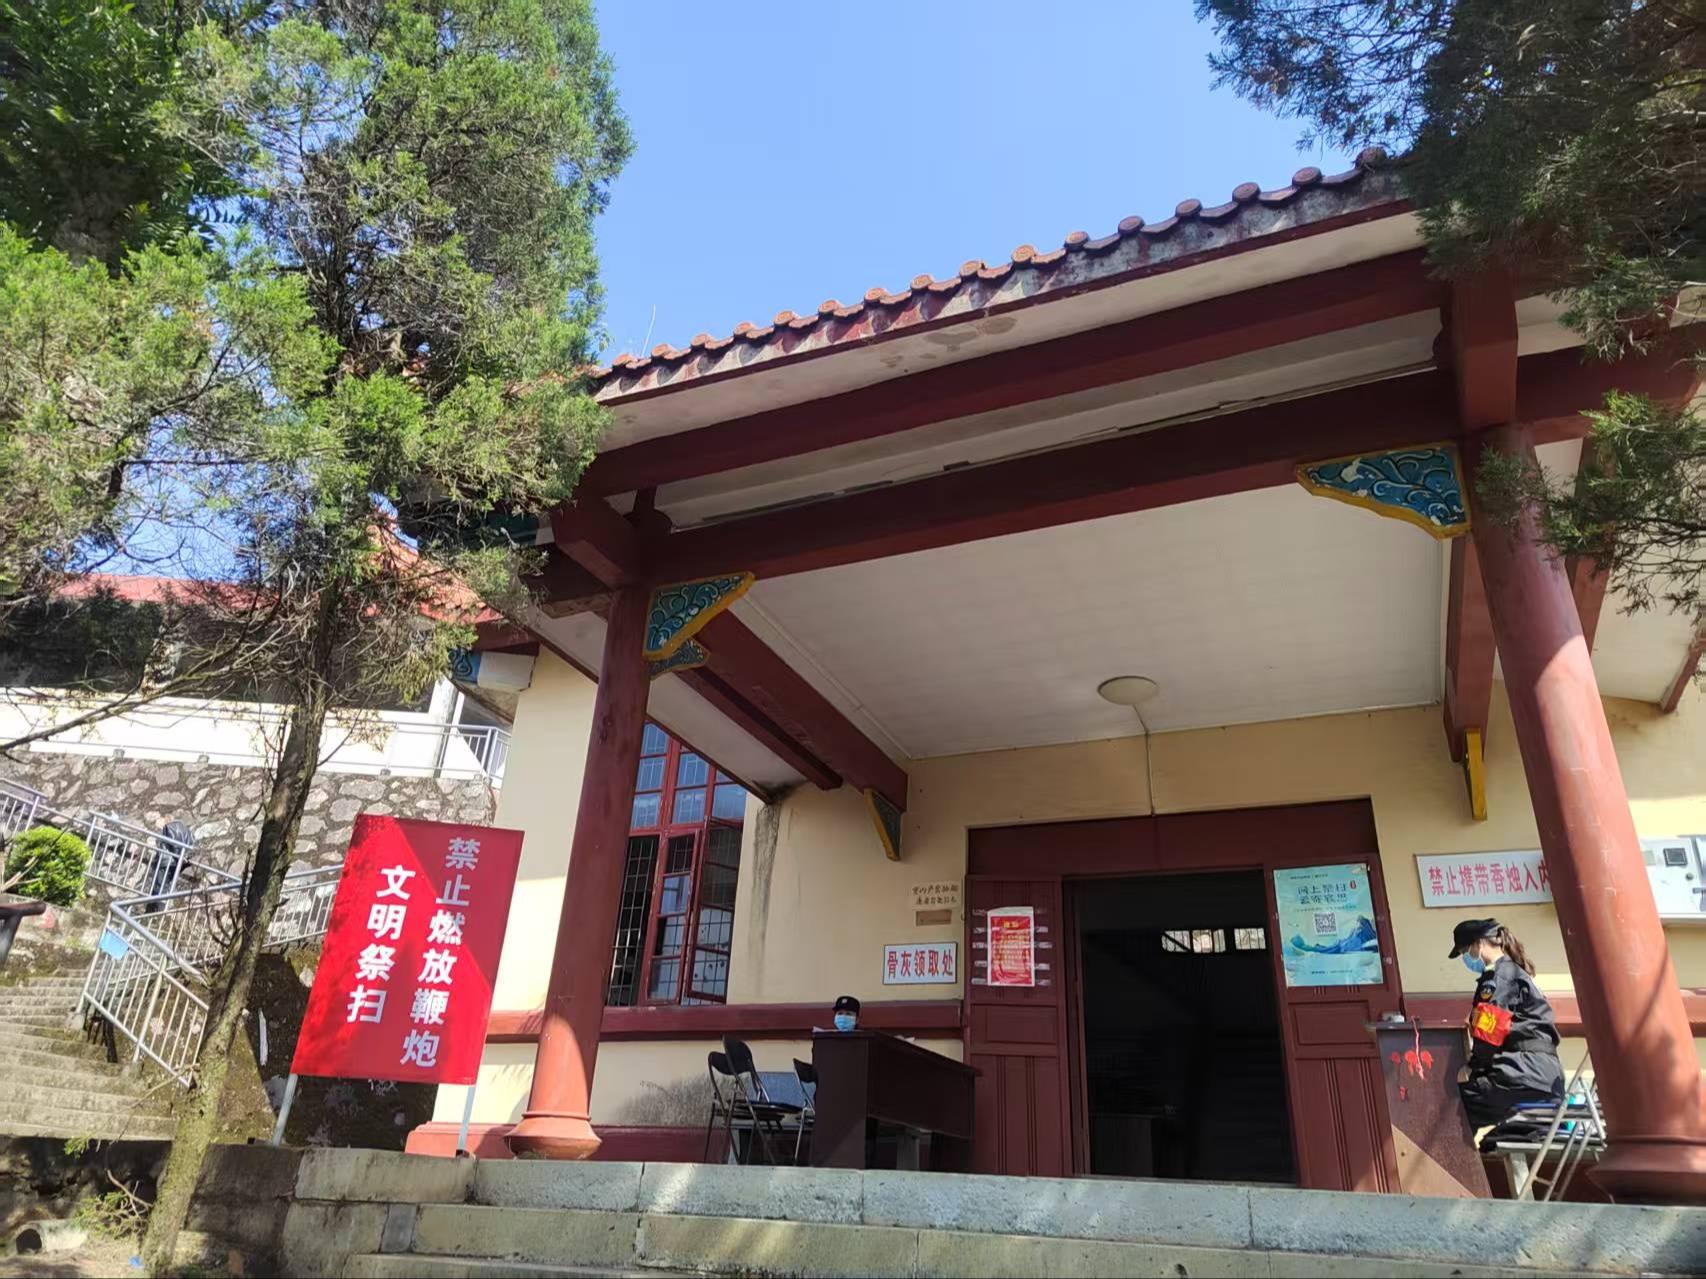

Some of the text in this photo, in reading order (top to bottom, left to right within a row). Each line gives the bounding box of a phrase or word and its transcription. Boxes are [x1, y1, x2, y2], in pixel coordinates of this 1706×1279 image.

[346, 865, 416, 1024] 文明祭扫
[400, 837, 482, 1067] 禁止燃放鞭炮
[887, 948, 953, 979] 骨灰领取处
